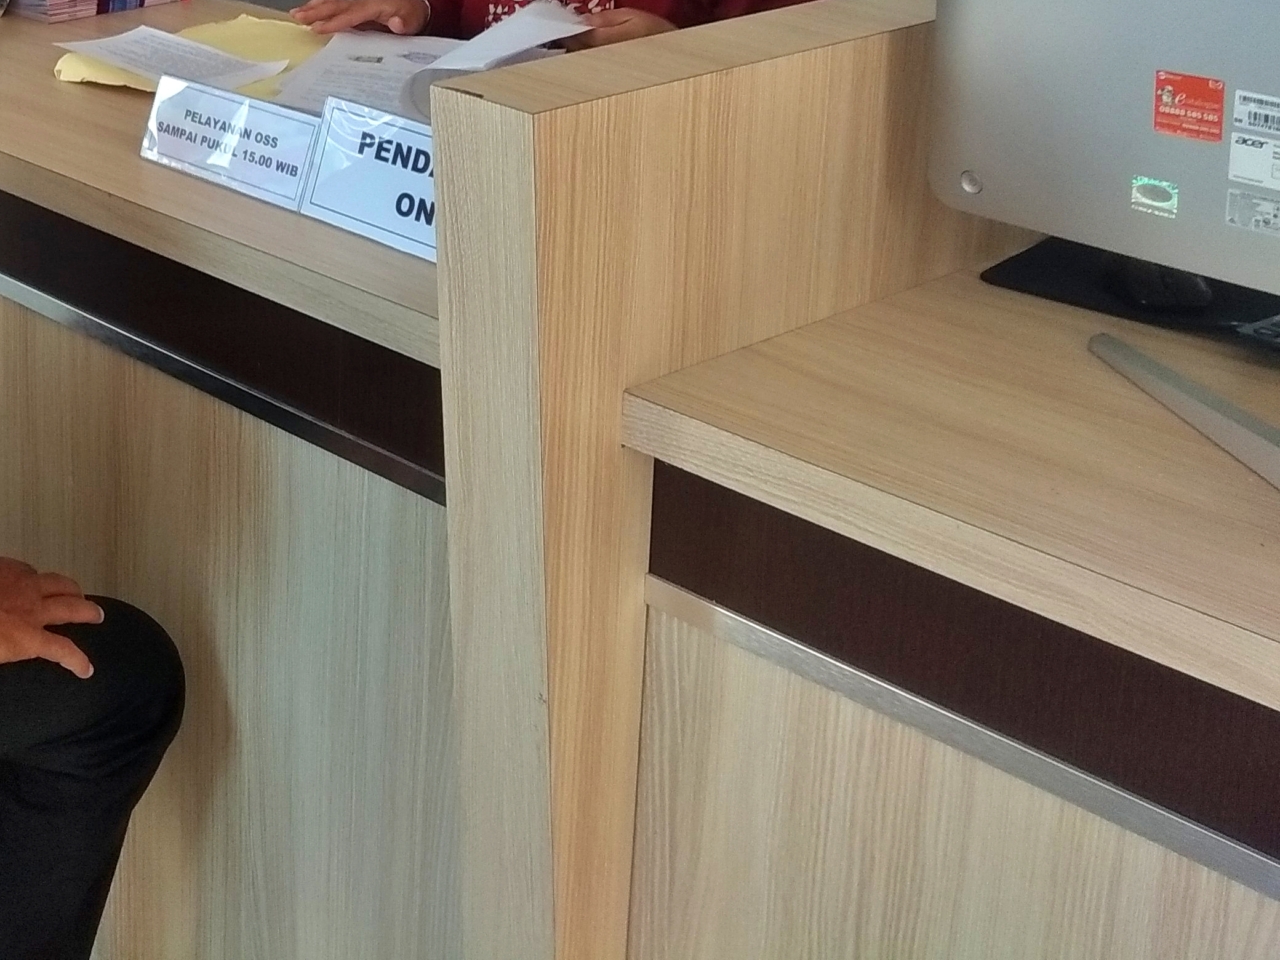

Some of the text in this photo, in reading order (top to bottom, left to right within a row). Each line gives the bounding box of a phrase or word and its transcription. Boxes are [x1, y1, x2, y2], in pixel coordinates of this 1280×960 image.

[157, 120, 299, 178] SAMPAI PUKUL 15.00 WIB
[184, 109, 279, 149] PELAYANAN OSS
[1235, 136, 1269, 149] acer
[357, 131, 434, 178] PEND
